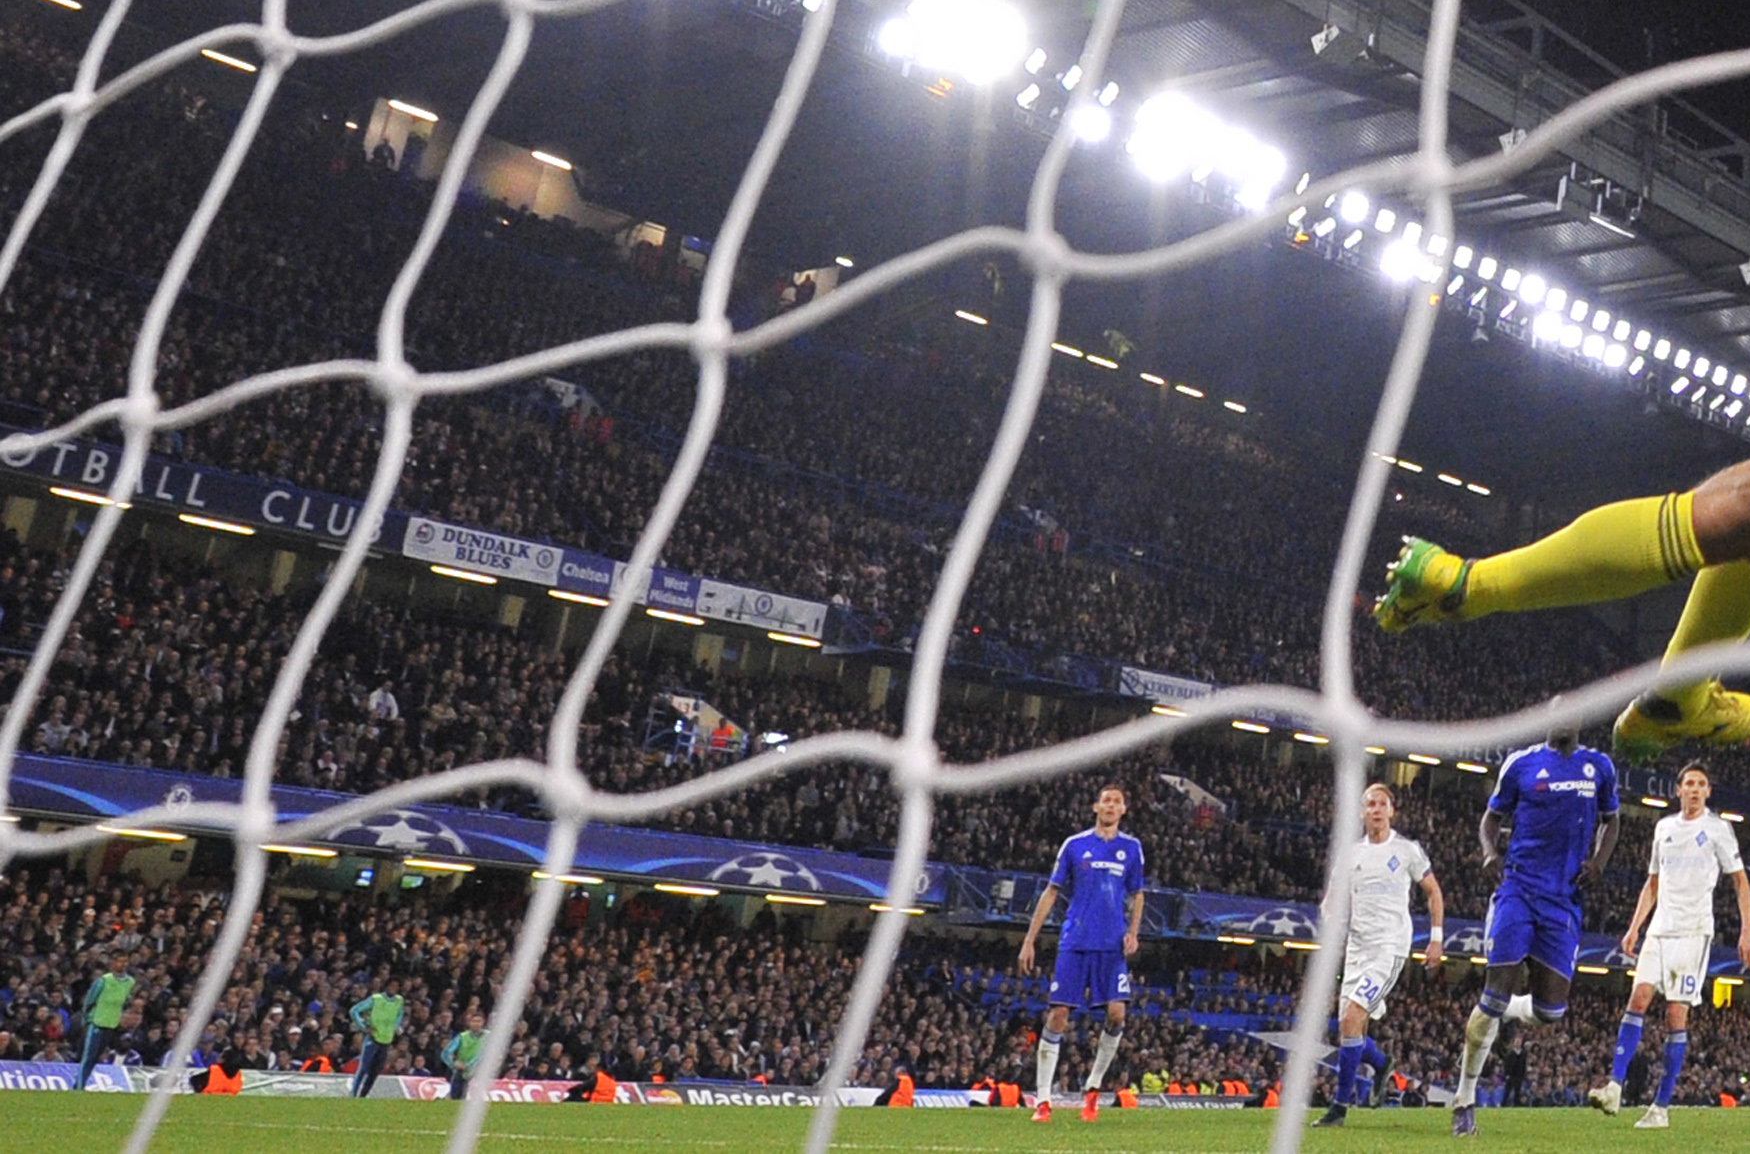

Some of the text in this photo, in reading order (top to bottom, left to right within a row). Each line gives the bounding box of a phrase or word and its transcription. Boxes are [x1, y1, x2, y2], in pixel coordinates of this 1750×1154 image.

[2, 433, 206, 508] OTBLL
[442, 528, 531, 559] DUNDALK
[455, 546, 513, 570] BLUES
[562, 562, 610, 584] Chelsea
[1354, 976, 1380, 1002] 24
[1679, 974, 1697, 995] 19
